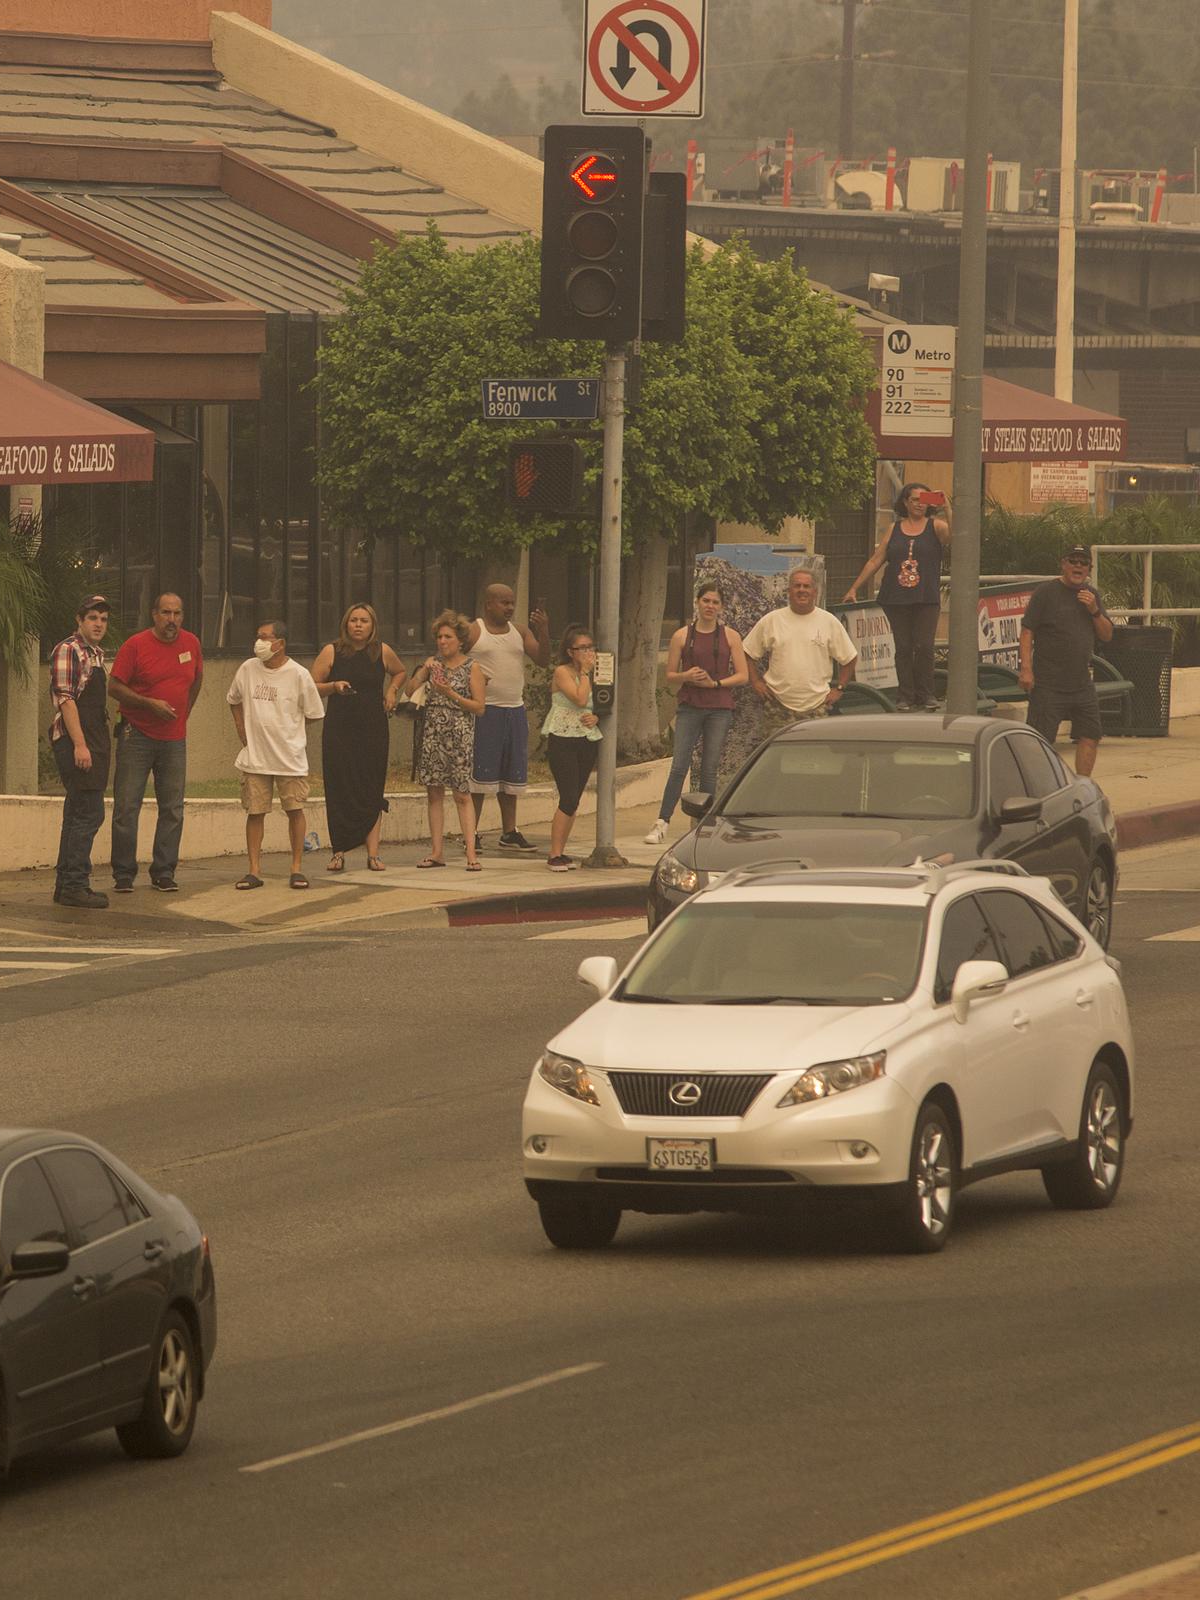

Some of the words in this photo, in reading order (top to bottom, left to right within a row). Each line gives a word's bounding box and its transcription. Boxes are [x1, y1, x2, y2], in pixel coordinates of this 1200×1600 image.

[914, 350, 951, 361] Metro
[887, 368, 904, 381] 90
[488, 382, 557, 402] Fenwick
[578, 381, 591, 396] St
[886, 384, 903, 398] 91
[488, 402, 520, 417] 8900
[885, 401, 911, 414] 222
[995, 427, 1027, 452] STEAKS
[1030, 427, 1072, 452] SEAFOOD
[1077, 428, 1083, 451] &
[1087, 427, 1121, 452] SALADS
[53, 445, 62, 473] &
[68, 443, 115, 473] SALADS
[653, 1150, 709, 1167] 6STG556
